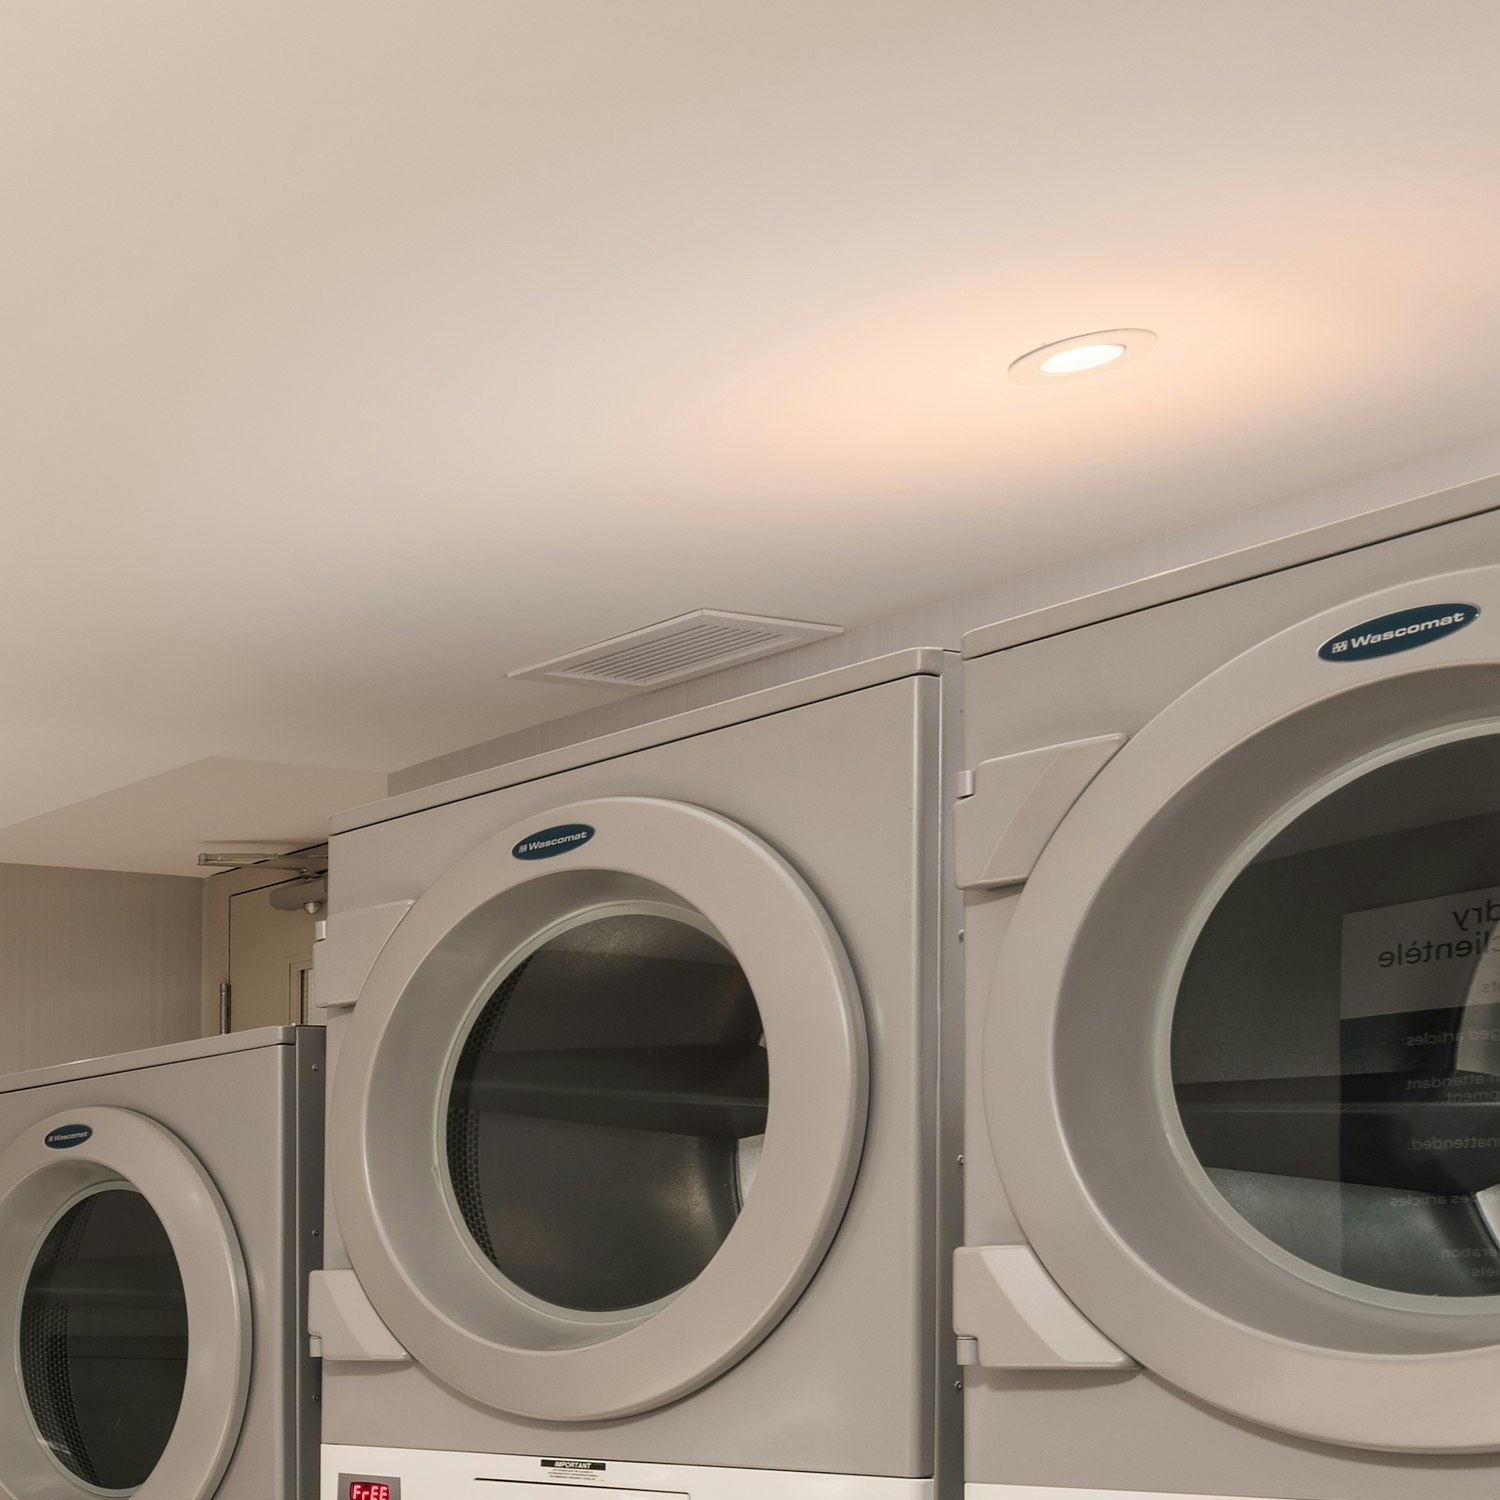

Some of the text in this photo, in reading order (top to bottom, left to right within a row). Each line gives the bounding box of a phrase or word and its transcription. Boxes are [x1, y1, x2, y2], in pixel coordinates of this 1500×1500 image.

[1350, 611, 1465, 649] Wascomat
[528, 831, 588, 850] Wascomat
[554, 1461, 592, 1469] IMPORTANT
